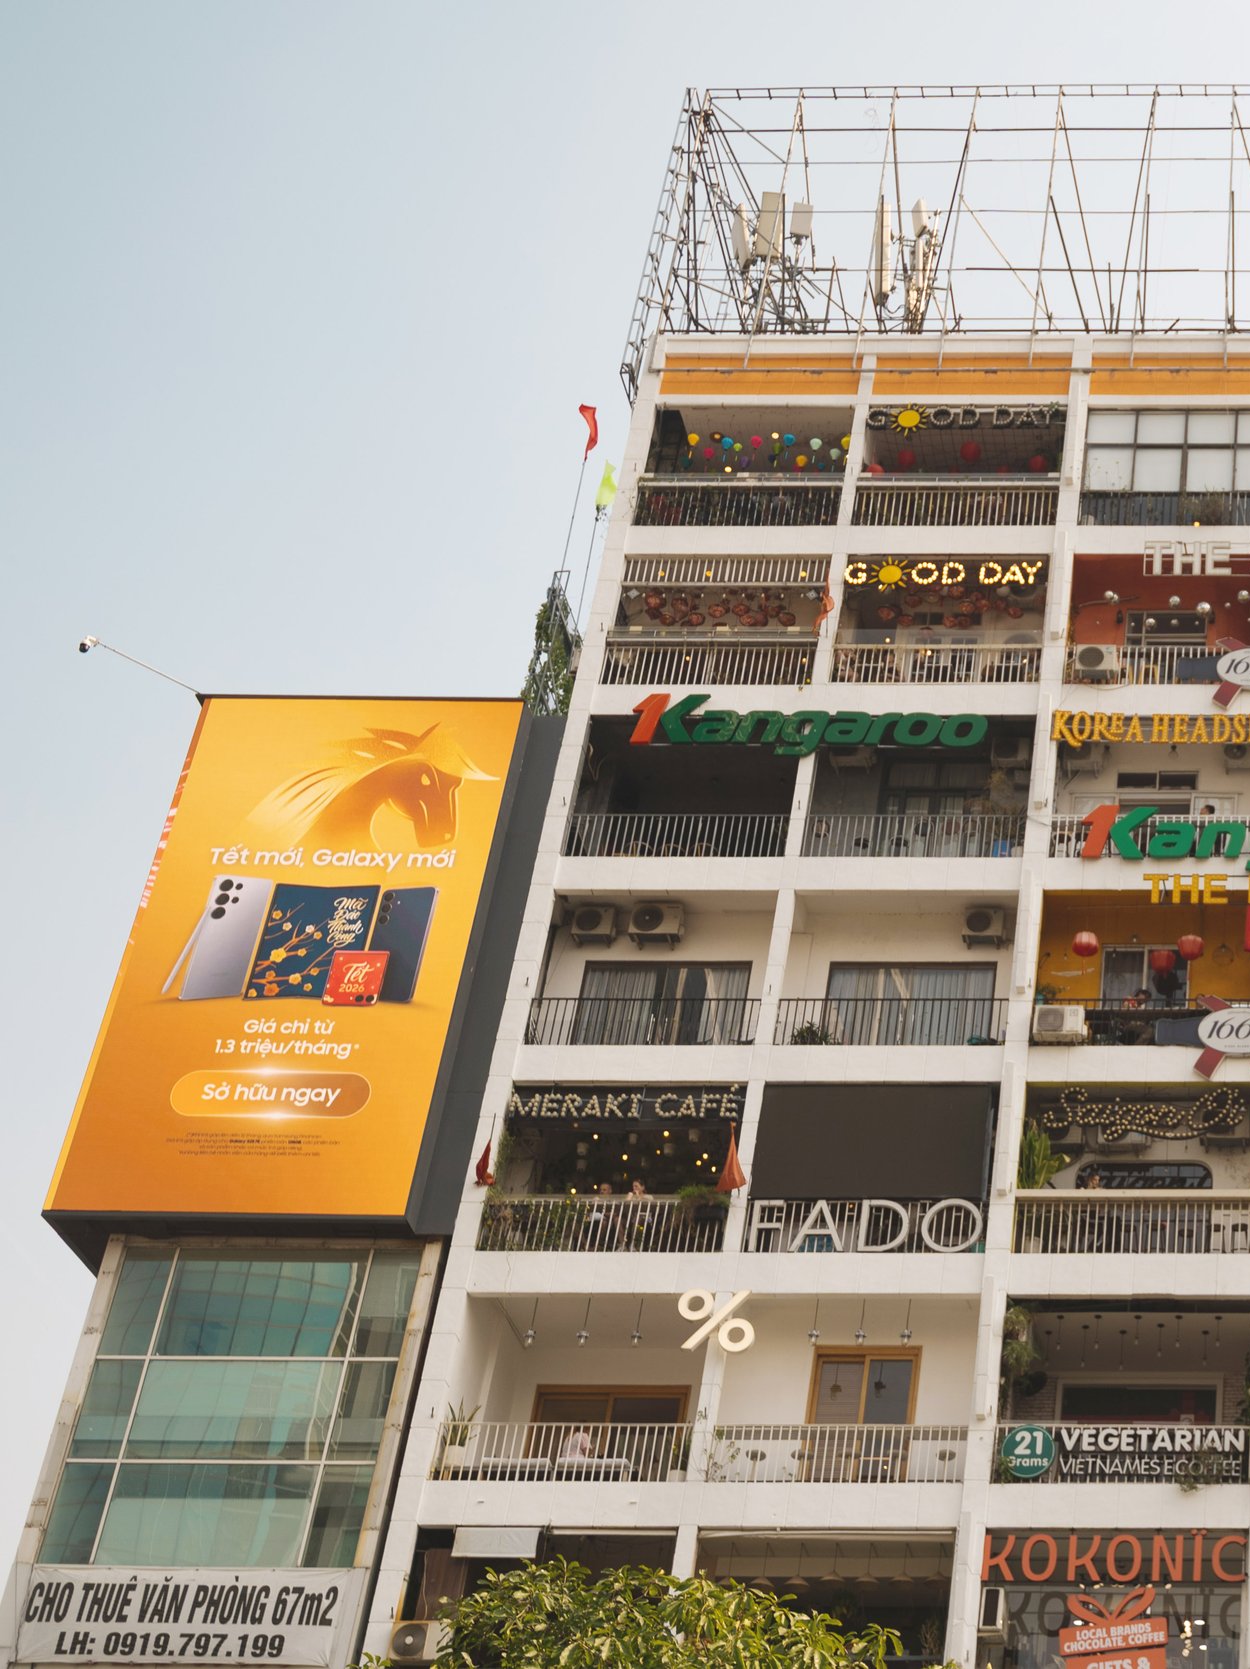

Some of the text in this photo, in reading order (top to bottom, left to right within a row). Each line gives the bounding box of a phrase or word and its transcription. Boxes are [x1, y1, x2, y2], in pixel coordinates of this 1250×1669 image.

[992, 403, 1058, 429] DAY
[1143, 540, 1232, 577] THE
[979, 560, 1042, 586] DAY
[1051, 710, 1144, 747] KOREA
[209, 843, 457, 873] Tết mới, Galaxy mới
[1143, 873, 1229, 905] THE
[342, 961, 375, 984] Tết
[339, 983, 366, 993] 2026
[243, 1018, 277, 1035] Giá
[313, 1018, 336, 1036] từ
[215, 1038, 236, 1054] 1.3
[201, 1081, 342, 1108] Sở hữu ngay
[509, 1083, 742, 1119] MERAKI CAFÉ
[747, 1198, 985, 1254] FADO
[1013, 1430, 1044, 1456] 21
[1060, 1427, 1246, 1453] VEGETARIAN
[24, 1574, 339, 1627] CHO THUÊ VĂN PHÒNG 67m2
[54, 1631, 286, 1658] LH: 0919.797.199
[1076, 1622, 1152, 1641] LOCAL BRANDS
[1128, 1631, 1166, 1646] COFFEE
